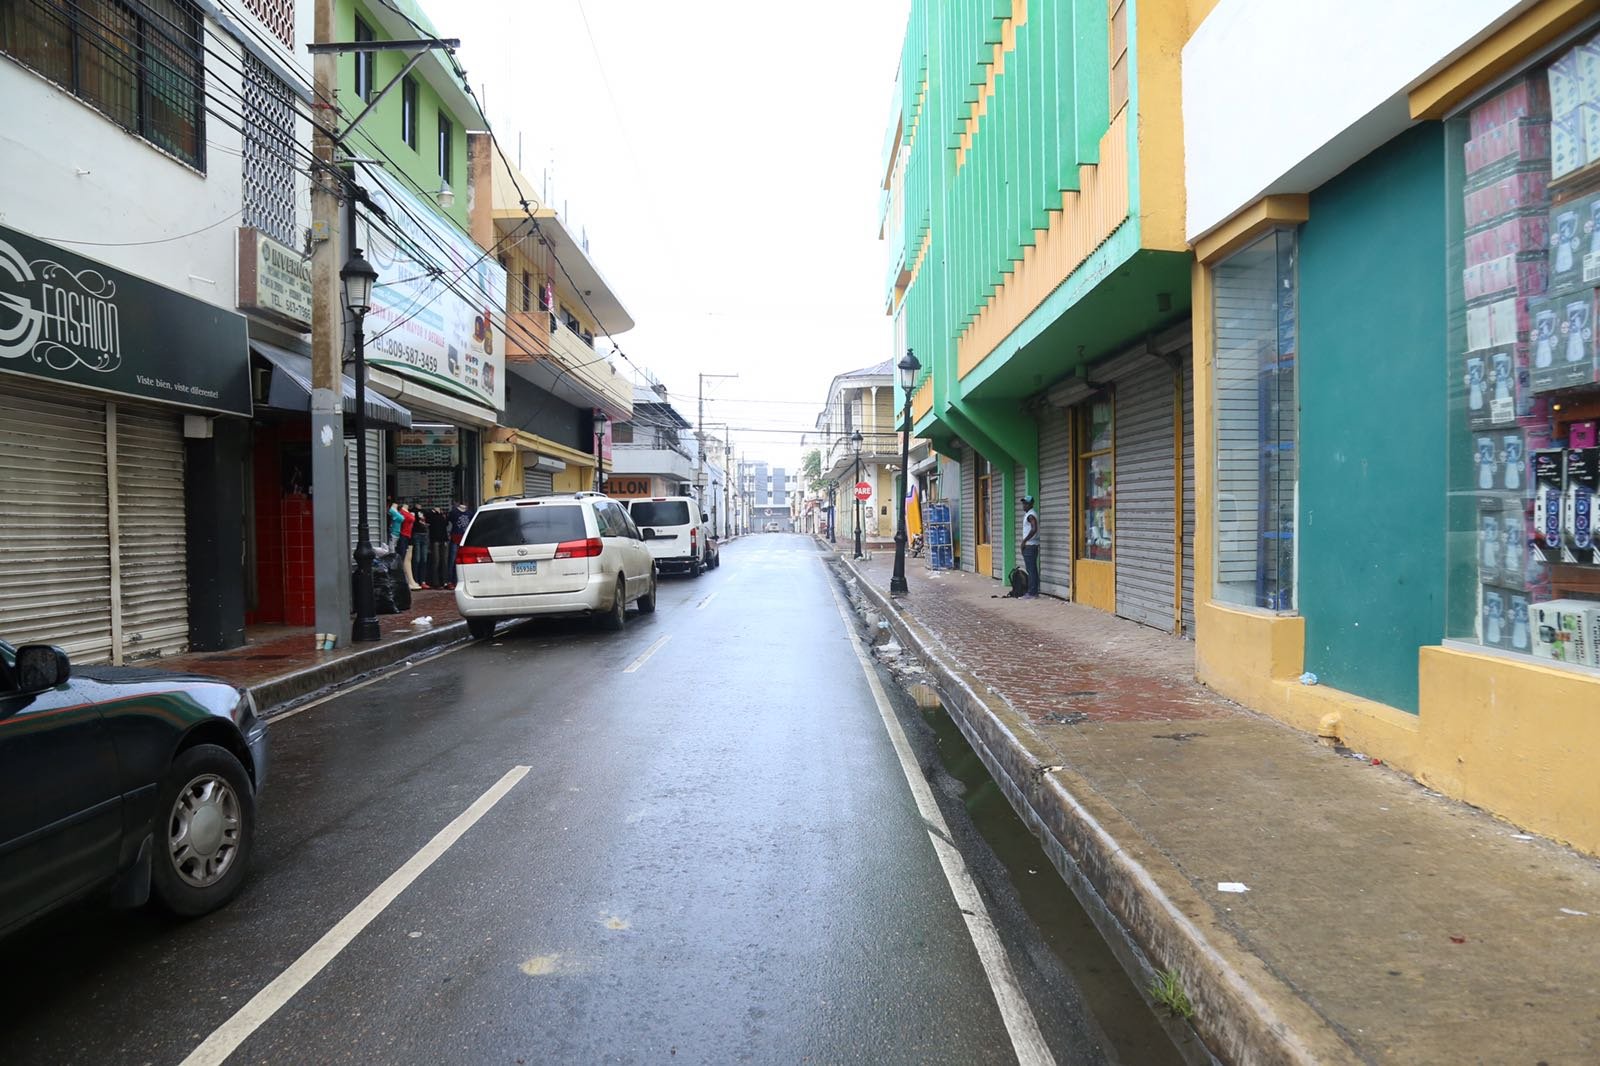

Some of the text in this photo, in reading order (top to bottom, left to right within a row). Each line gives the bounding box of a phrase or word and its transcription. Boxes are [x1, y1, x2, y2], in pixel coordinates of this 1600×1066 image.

[42, 283, 121, 358] FASHION
[136, 374, 154, 386] Viste
[155, 378, 173, 390] bien,
[174, 382, 190, 393] viste
[855, 487, 871, 495] PARE
